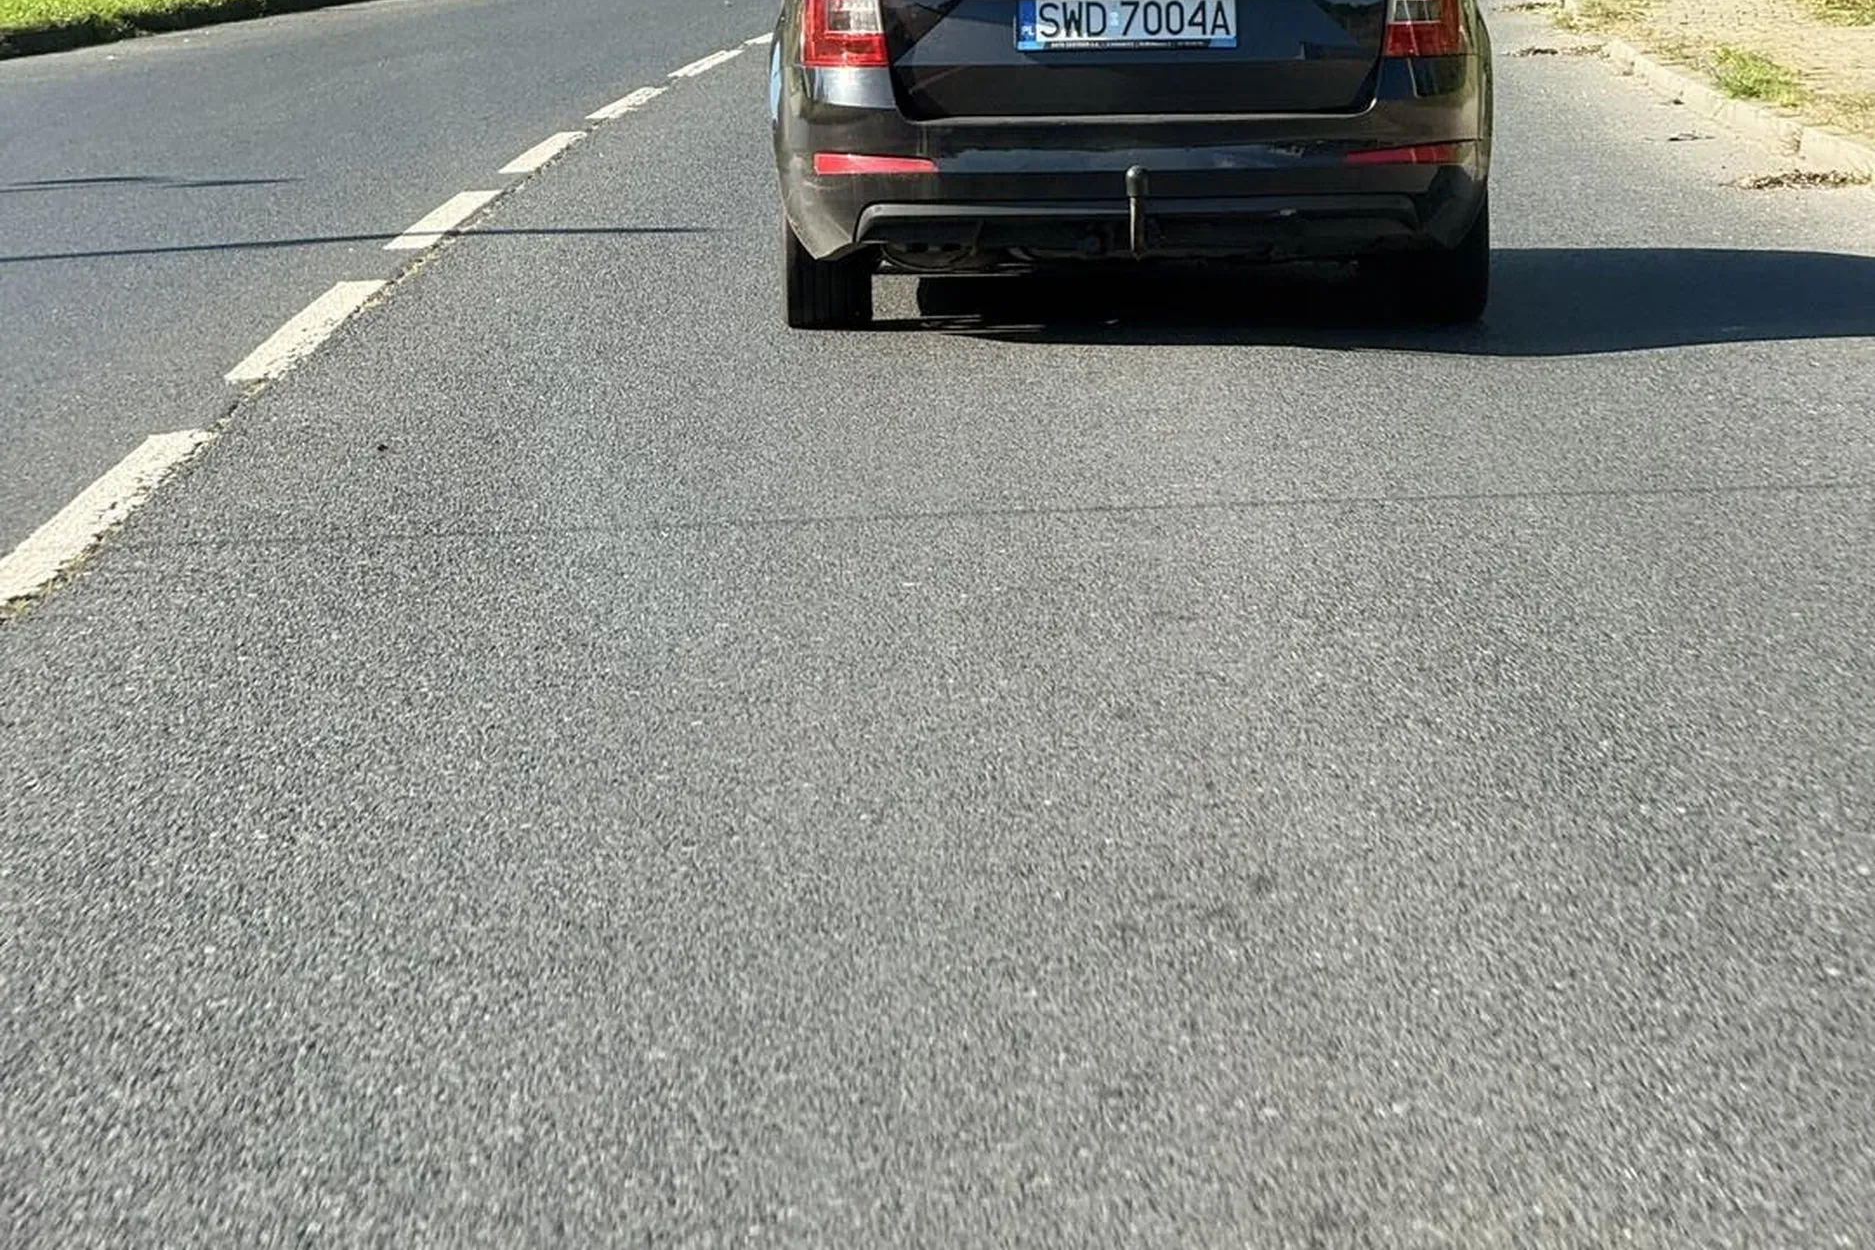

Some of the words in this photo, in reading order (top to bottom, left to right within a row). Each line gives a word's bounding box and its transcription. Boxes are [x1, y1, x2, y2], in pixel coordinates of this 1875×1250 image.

[1021, 25, 1035, 37] PL
[1040, 1, 1107, 38] SWD
[1120, 0, 1231, 36] 7004A
